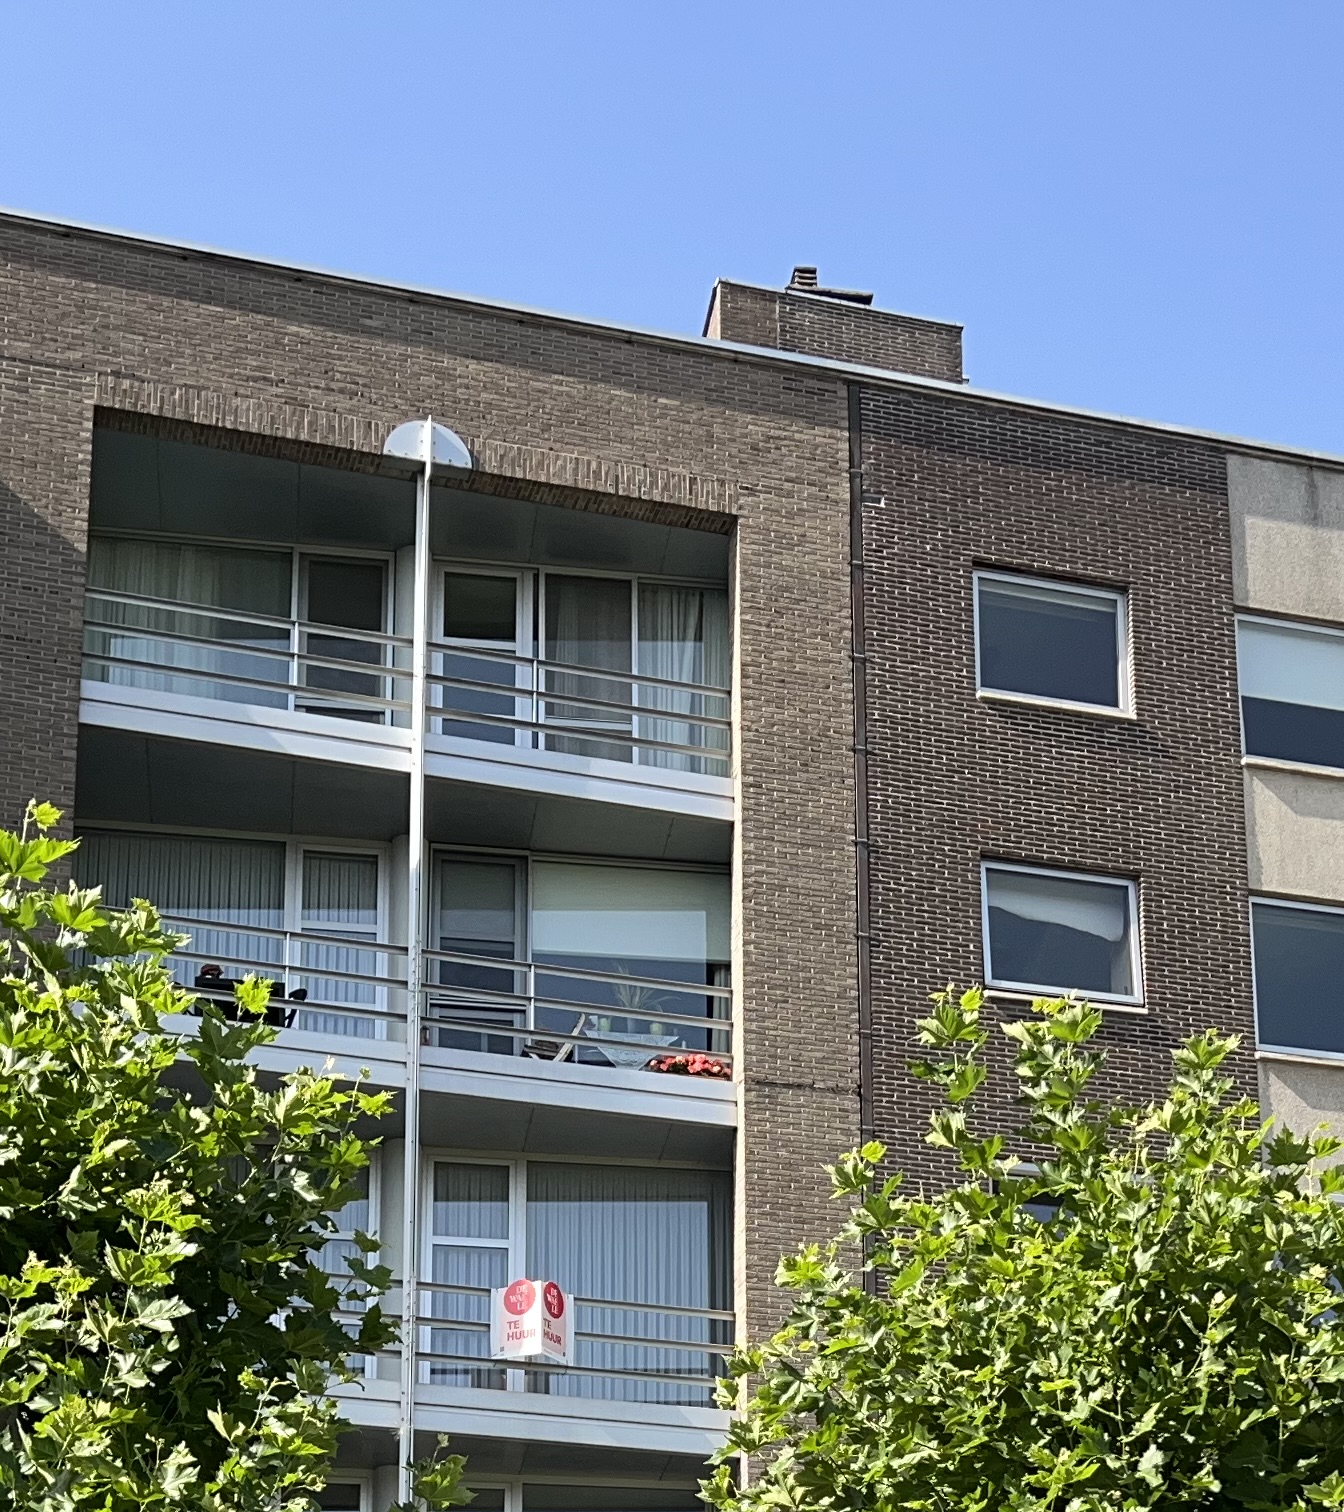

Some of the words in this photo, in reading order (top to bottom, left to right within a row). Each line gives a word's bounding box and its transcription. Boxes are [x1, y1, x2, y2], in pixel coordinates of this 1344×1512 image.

[507, 1320, 520, 1330] TE
[543, 1317, 552, 1330] TE
[507, 1329, 536, 1341] HUUR
[543, 1329, 562, 1346] HUUR
